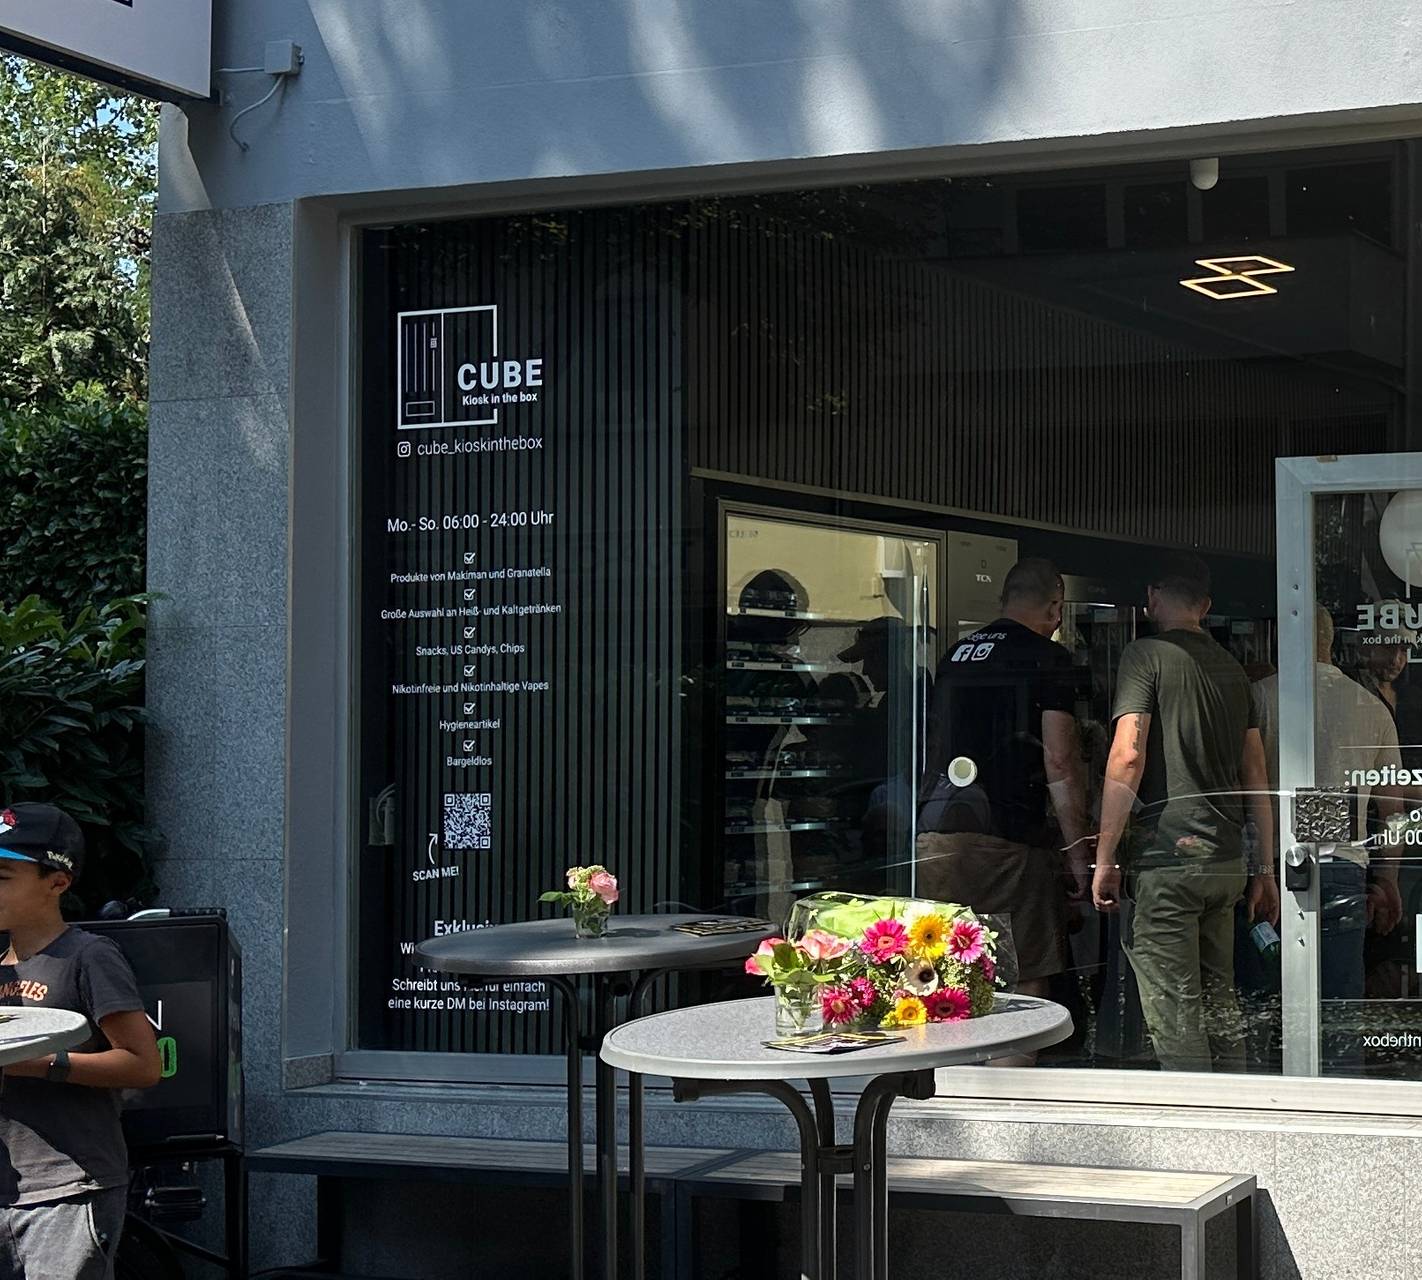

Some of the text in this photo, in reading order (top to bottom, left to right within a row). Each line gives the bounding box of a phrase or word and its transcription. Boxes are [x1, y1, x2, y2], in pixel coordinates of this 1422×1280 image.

[457, 358, 543, 391] CUBE
[462, 391, 538, 406] Kiosk in the box
[417, 435, 543, 456] cube_kioskinthebox
[418, 516, 440, 531] So.
[443, 514, 480, 529] 06:00
[490, 511, 527, 527] 24:00
[530, 509, 554, 525] Uhr
[390, 567, 551, 584] Produkte von Makiman und Granatella
[381, 608, 407, 619] Große
[408, 607, 445, 618] Auswahl
[446, 608, 457, 617] an
[483, 605, 500, 615] und
[501, 603, 562, 616] Kaltgetränken
[415, 643, 525, 657] Snacks, US Candys, Chips
[392, 680, 549, 694] Nikotinfreie und Nikotinhaltige Vapes
[439, 718, 500, 732] Hygieneartikel
[446, 756, 492, 769] Bargeldlos
[412, 866, 460, 882] SCAN ME!
[392, 978, 438, 992] Schreibt
[440, 981, 461, 992] uns
[388, 996, 550, 1014] eine kurze DM bei Instagram!
